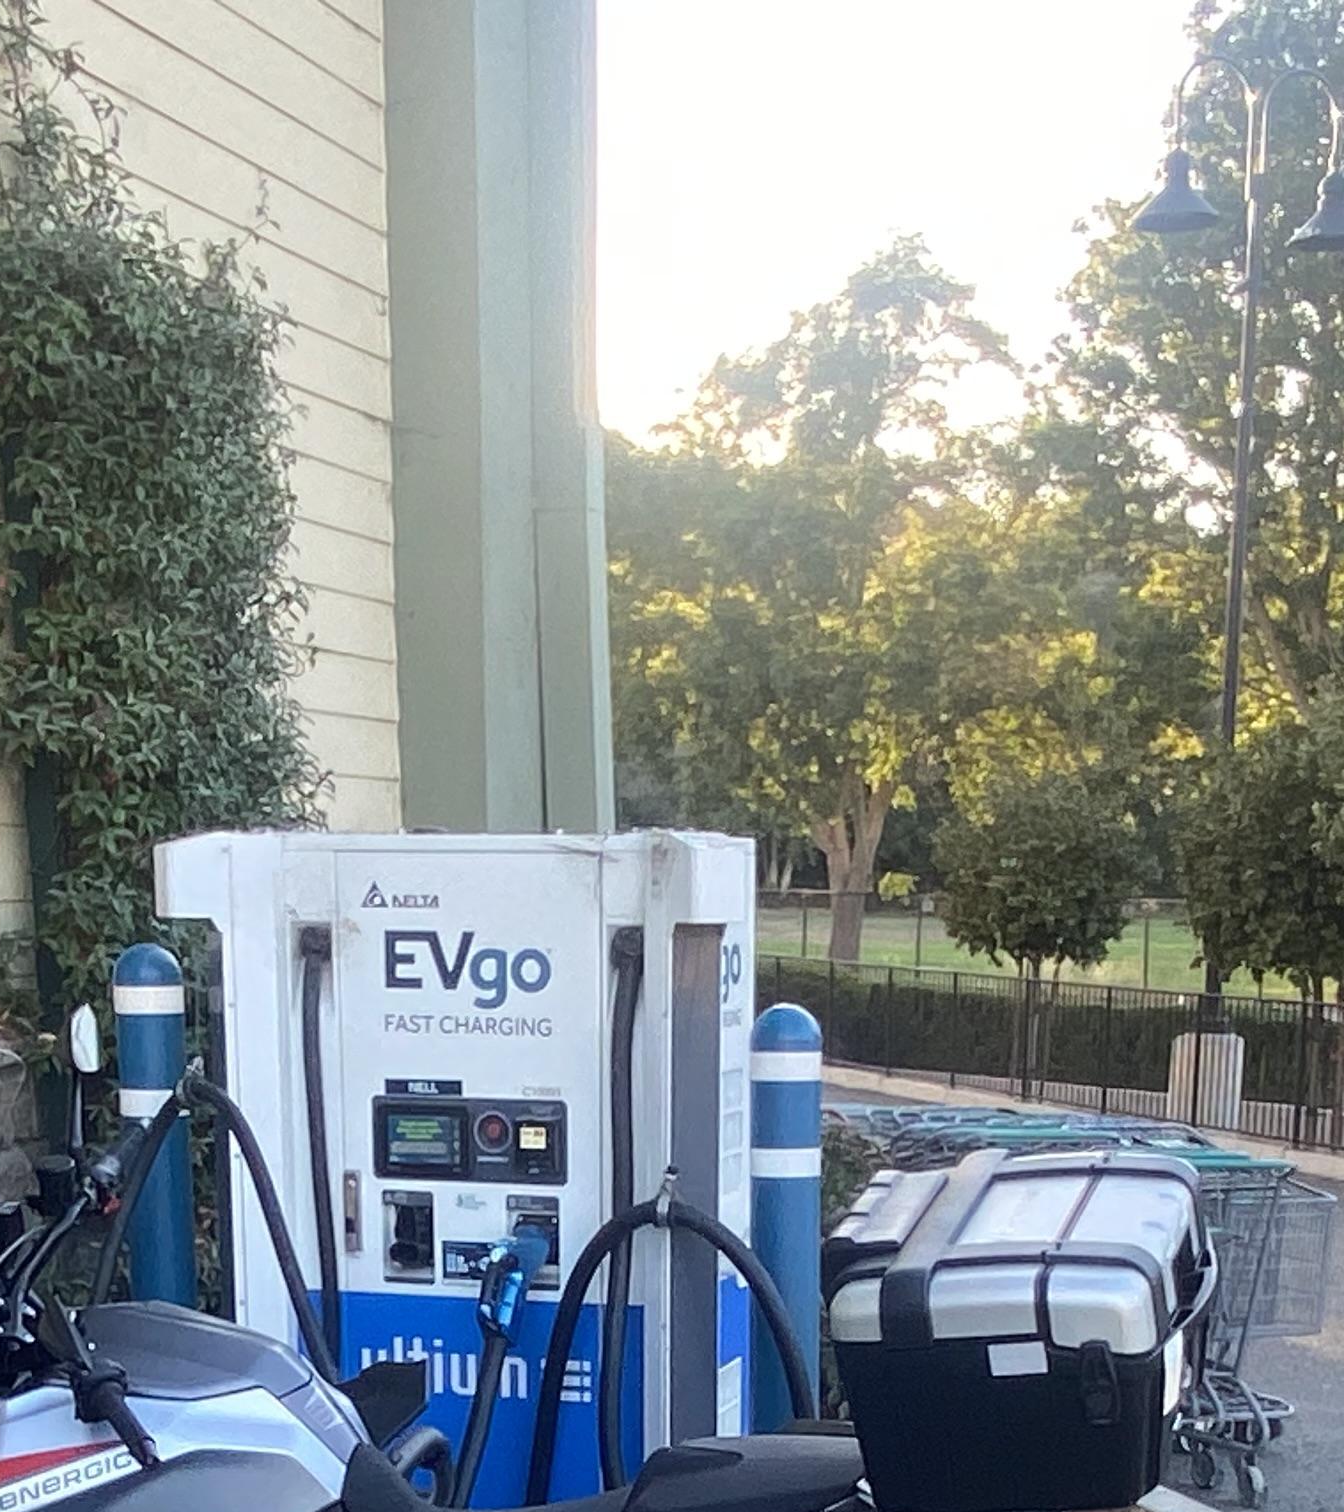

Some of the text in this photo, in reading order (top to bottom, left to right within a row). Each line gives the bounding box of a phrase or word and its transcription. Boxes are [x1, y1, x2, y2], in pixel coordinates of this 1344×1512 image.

[384, 930, 552, 1010] EVgo
[384, 1013, 553, 1038] FAST CHARGING
